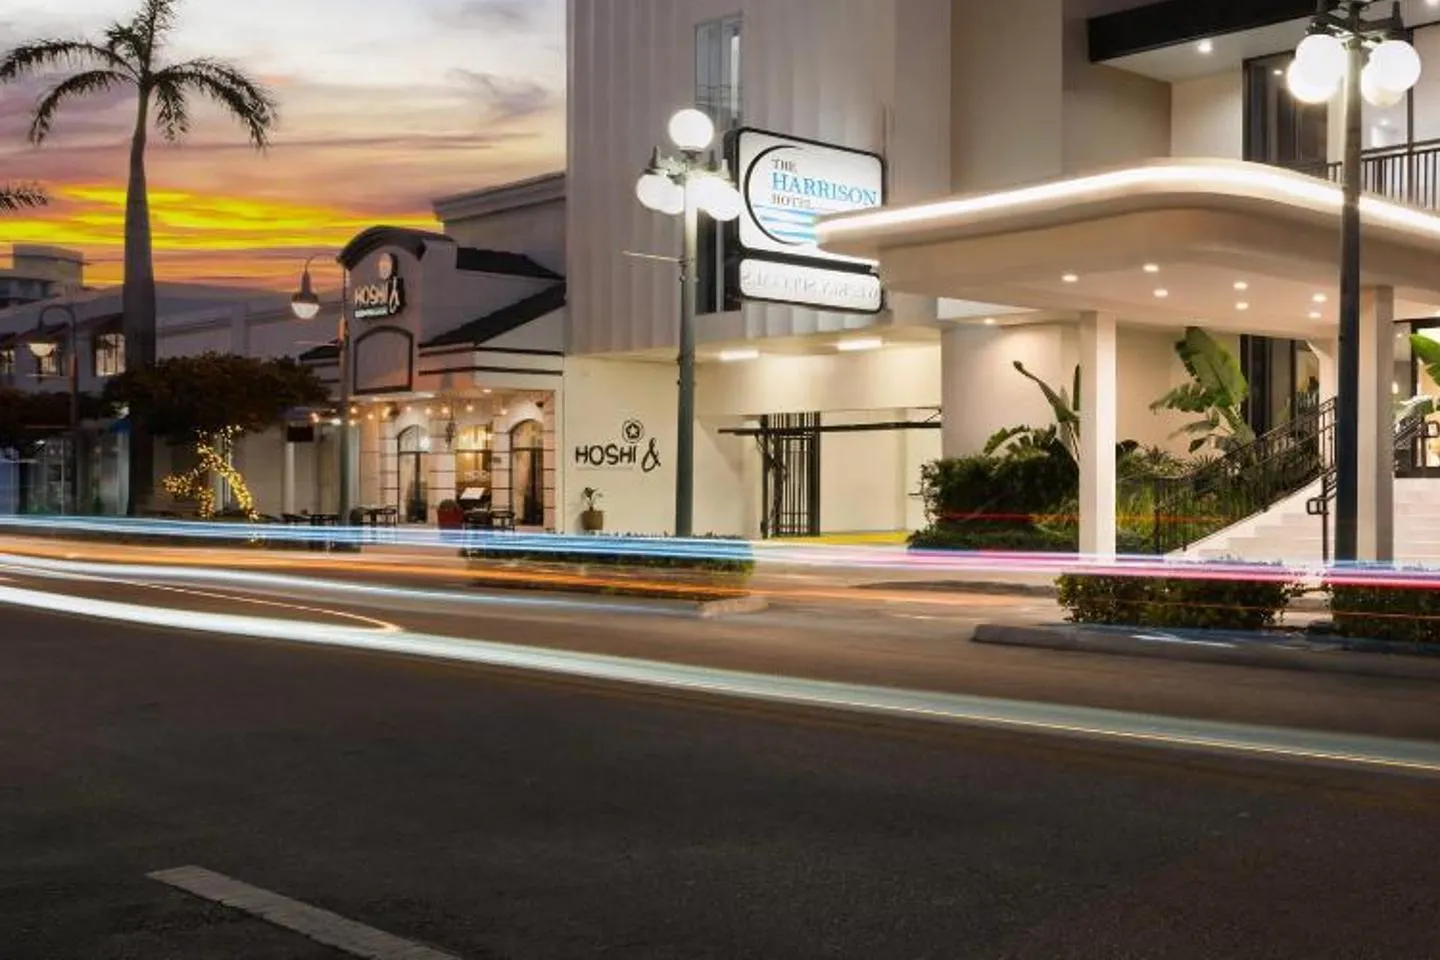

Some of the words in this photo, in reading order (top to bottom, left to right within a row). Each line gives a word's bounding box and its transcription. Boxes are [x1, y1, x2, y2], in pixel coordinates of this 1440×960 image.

[771, 159, 797, 173] THE
[771, 171, 877, 206] HARRISON
[575, 443, 637, 466] HOSHI
